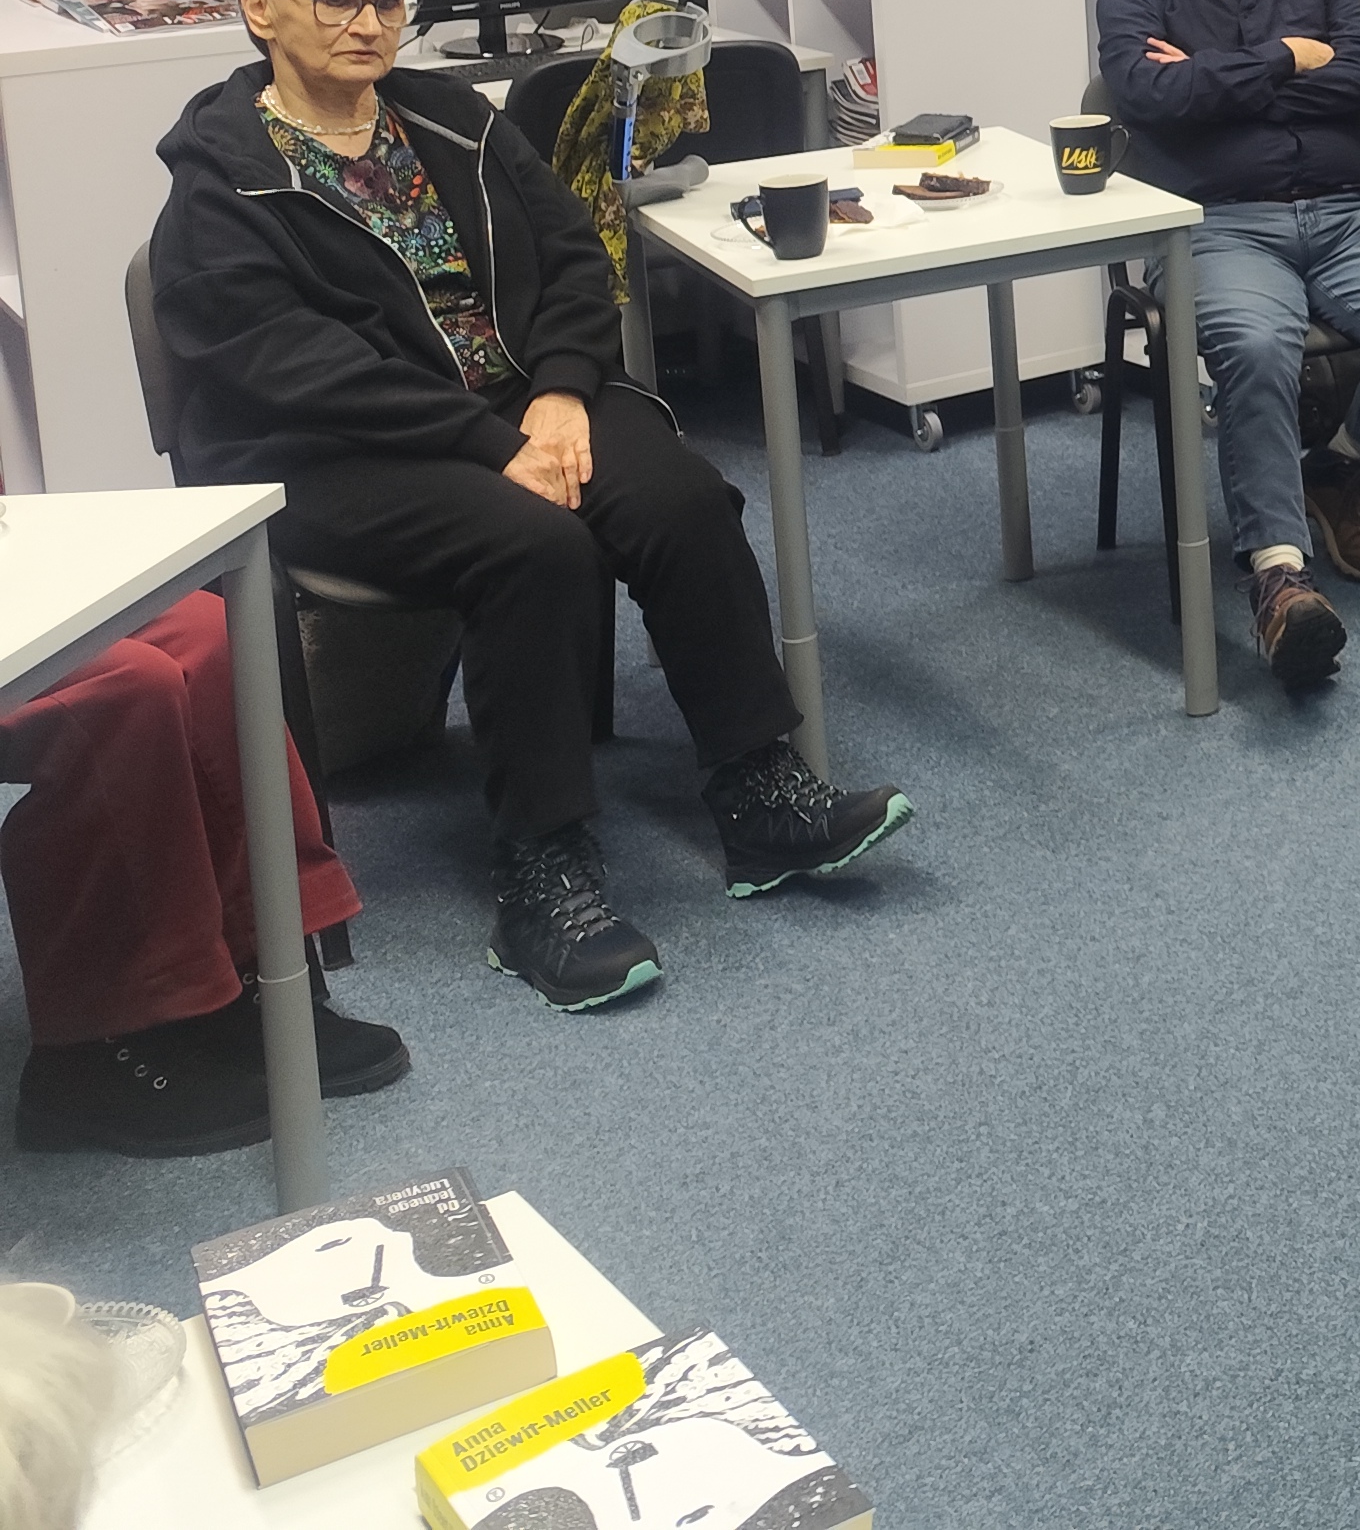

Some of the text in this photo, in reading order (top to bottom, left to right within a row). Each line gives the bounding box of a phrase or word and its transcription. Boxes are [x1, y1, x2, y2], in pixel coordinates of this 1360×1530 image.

[371, 1177, 451, 1208] Lucypera
[387, 1186, 456, 1216] jednego
[436, 1198, 460, 1216] Od
[360, 1298, 511, 1358] Dziewit-Meller
[464, 1313, 516, 1337] Anna
[450, 1420, 508, 1459] Anna
[458, 1387, 614, 1474] Dziewit-Meller
